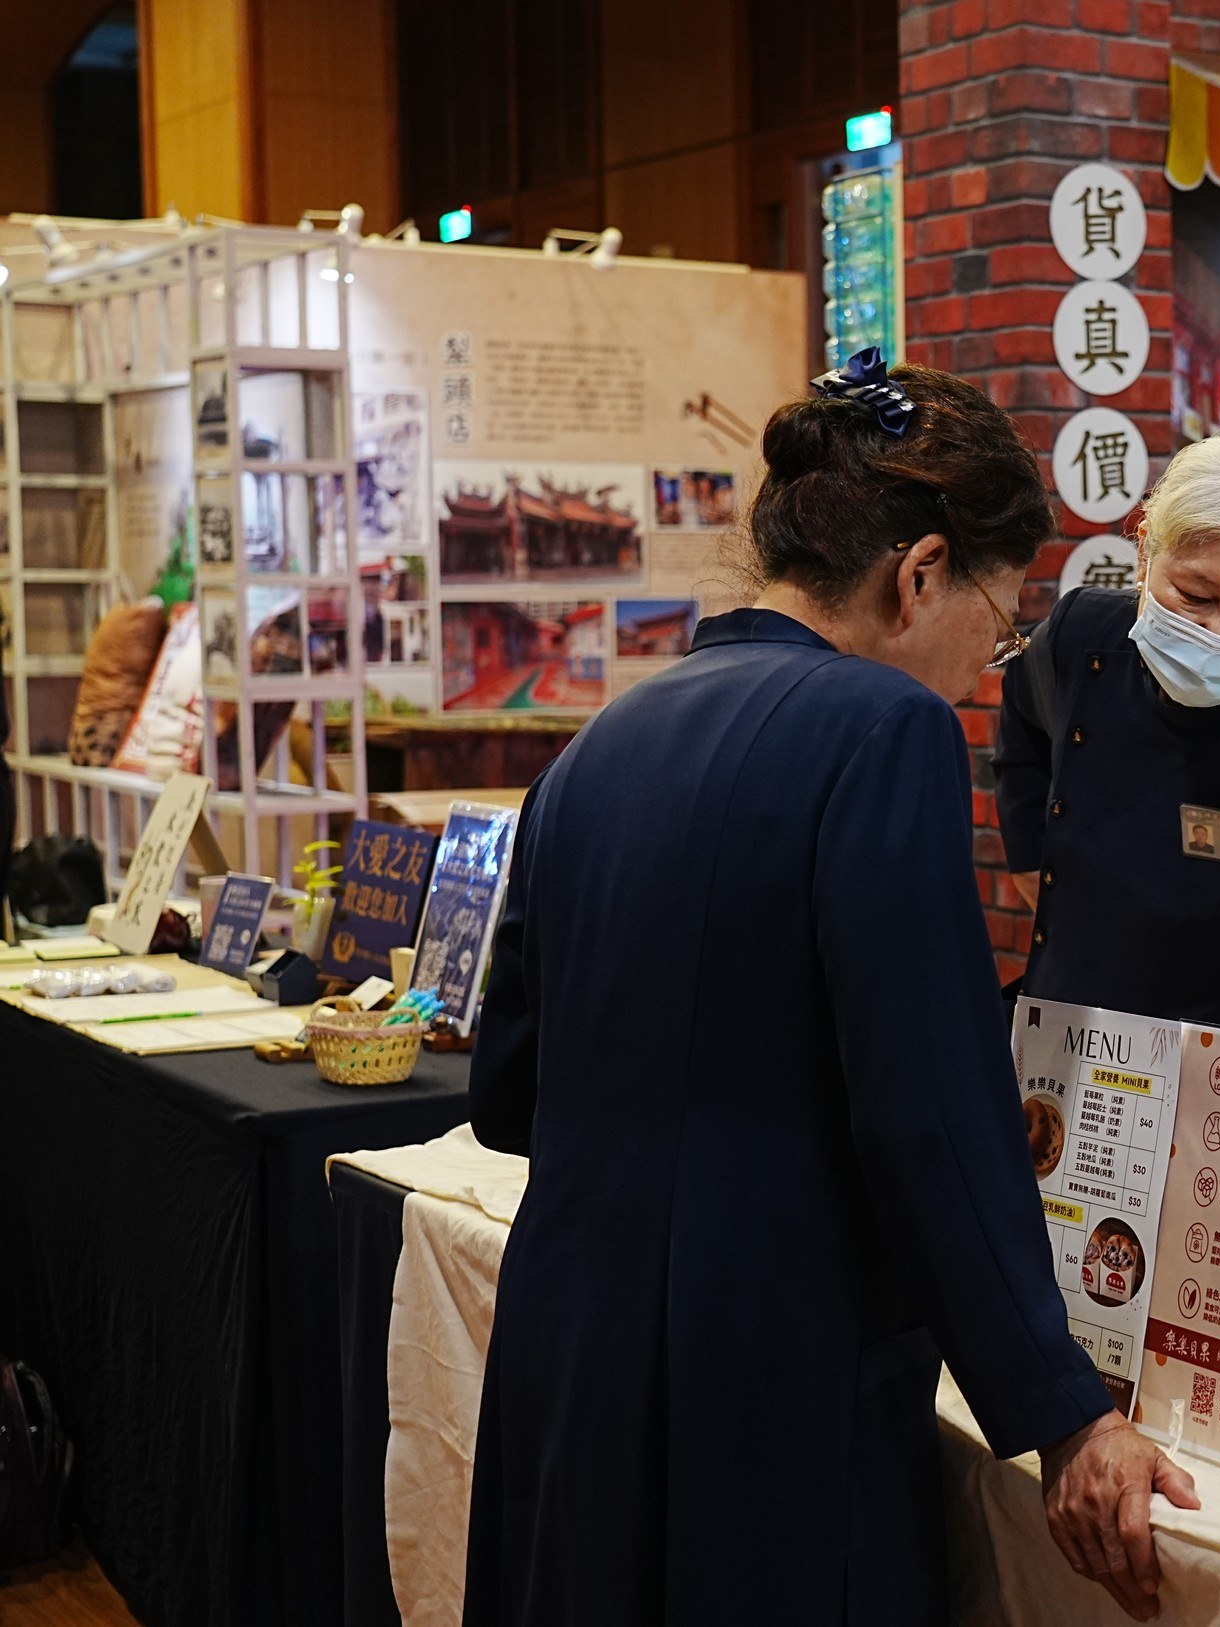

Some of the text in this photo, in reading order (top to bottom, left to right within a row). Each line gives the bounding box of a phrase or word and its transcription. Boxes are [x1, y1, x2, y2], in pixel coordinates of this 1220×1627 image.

[347, 829, 428, 886] 大愛之友
[1063, 1025, 1132, 1065] MENU
[1093, 1069, 1119, 1087] 全家營養
[1027, 1076, 1066, 1098] 樂樂貝果
[1139, 1119, 1153, 1129] $40
[1132, 1165, 1146, 1175] $30
[1128, 1196, 1142, 1207] $30
[1065, 1254, 1078, 1265] $60
[1107, 1338, 1124, 1351] $100
